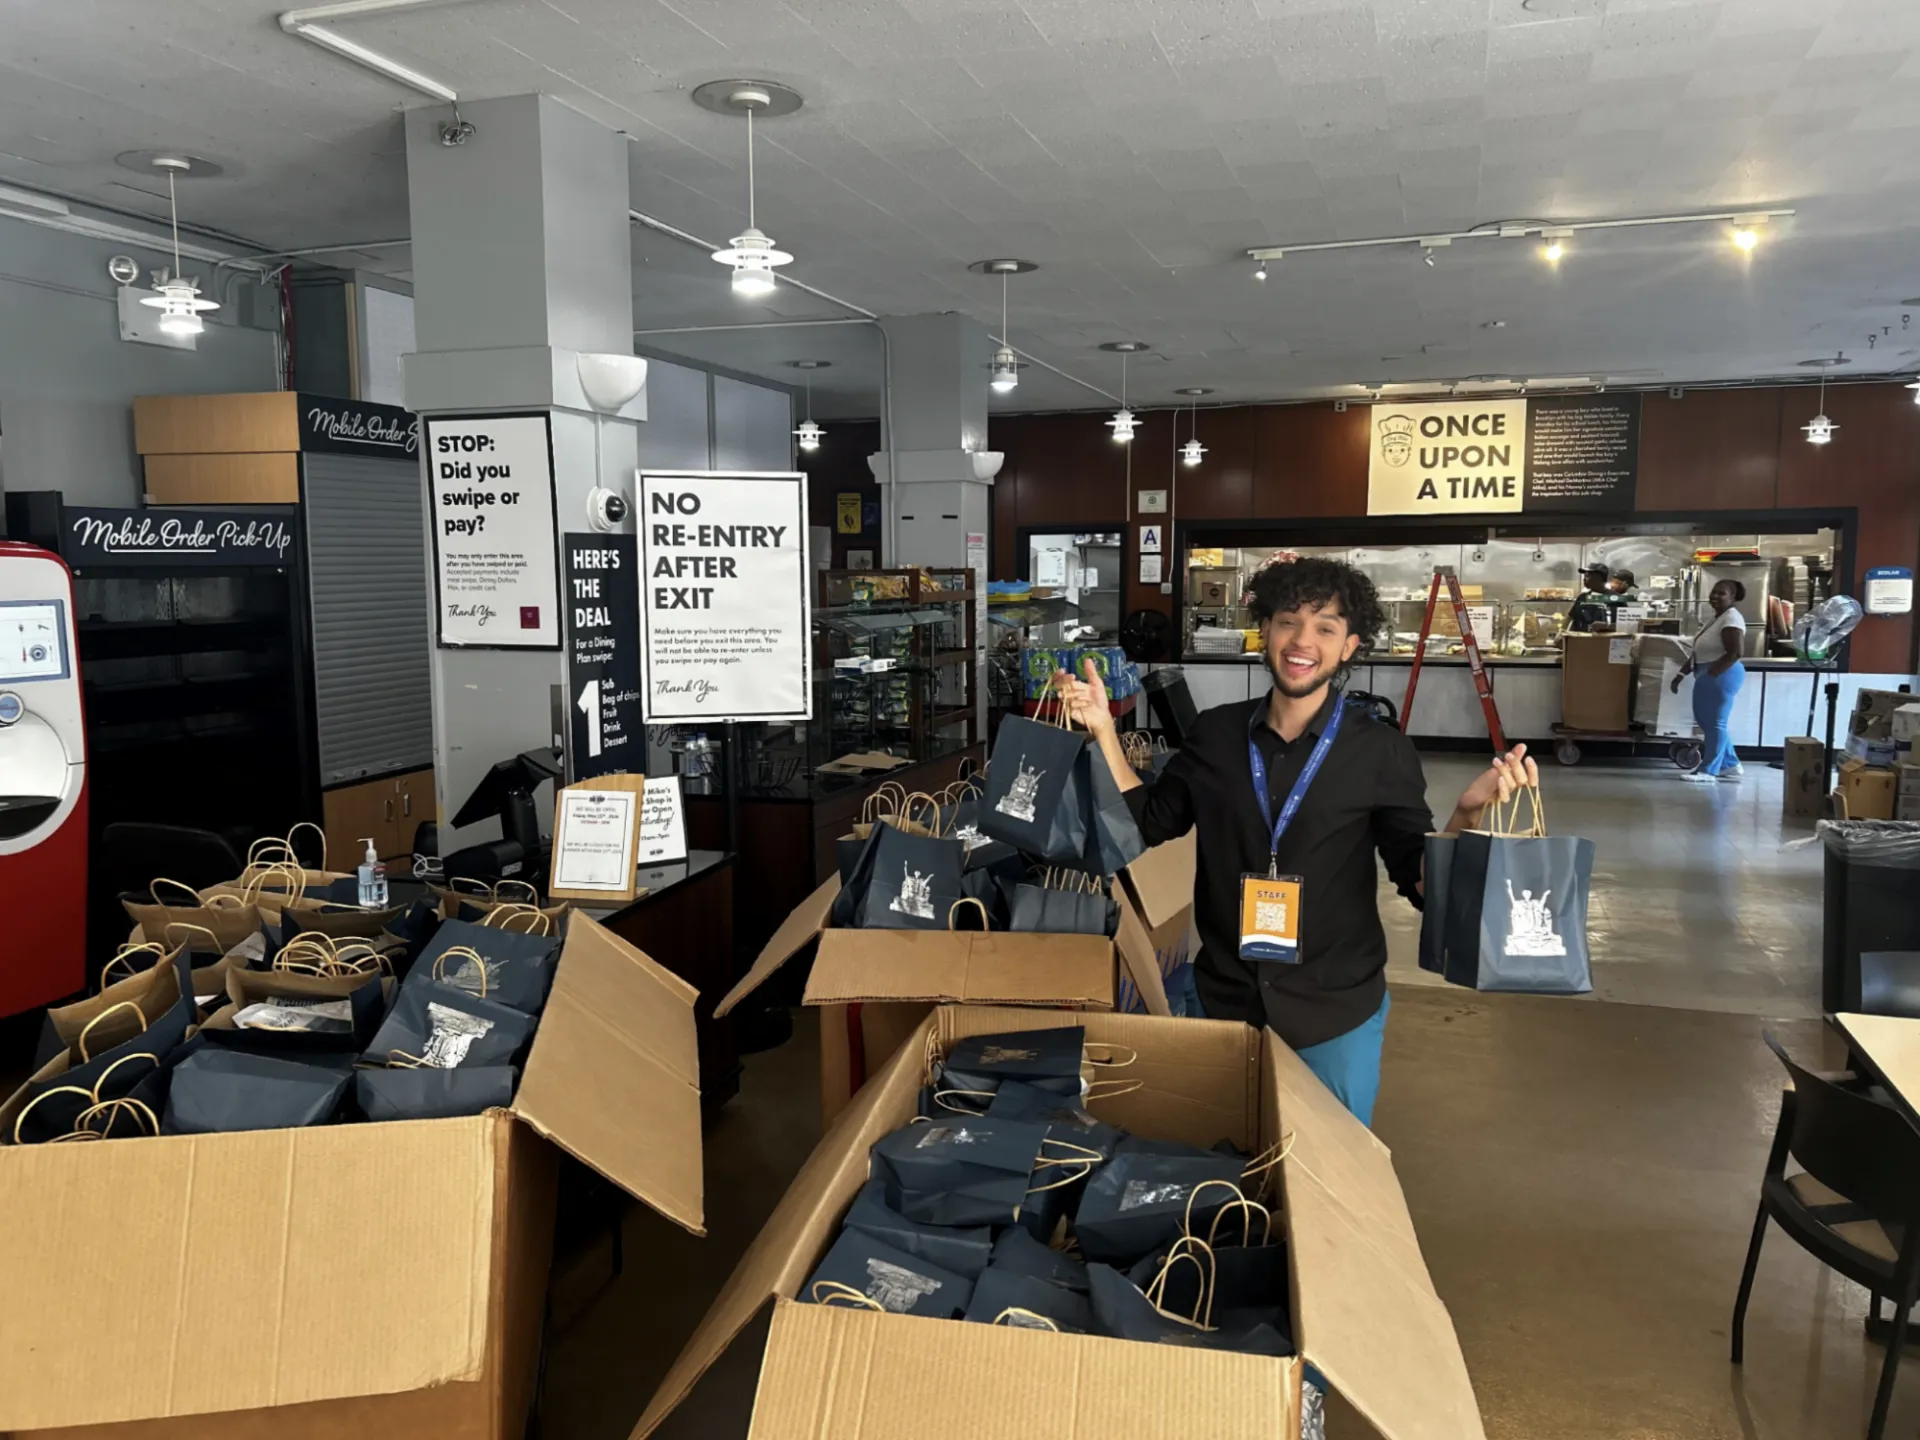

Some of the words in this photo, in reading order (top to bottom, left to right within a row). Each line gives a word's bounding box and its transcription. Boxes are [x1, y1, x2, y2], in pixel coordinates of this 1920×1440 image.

[308, 408, 366, 438] Mobile
[368, 416, 405, 441] Order
[1420, 414, 1506, 438] ONCE
[438, 435, 495, 453] STOP:
[1420, 446, 1510, 469] UPON
[440, 461, 472, 479] Did
[477, 464, 510, 482] you
[443, 488, 496, 509] swipe
[501, 492, 519, 505] or
[1417, 479, 1438, 499] A
[1447, 477, 1515, 498] TIME
[652, 492, 701, 515] NO
[445, 515, 485, 535] pay?
[74, 516, 158, 552] Mobile
[160, 520, 216, 548] Order
[217, 520, 290, 558] Pick-Up
[653, 524, 787, 548] RE-ENTRY
[1144, 529, 1157, 545] A
[573, 549, 620, 569] HERE'S
[653, 556, 738, 578] AFTER
[573, 579, 600, 598] THE
[654, 587, 714, 609] EXIT
[448, 604, 476, 617] Thank
[477, 605, 496, 626] You
[576, 608, 611, 628] DEAL
[576, 639, 586, 649] For
[595, 637, 615, 649] Dining
[576, 654, 591, 664] Plan
[592, 652, 613, 664] swipe:
[602, 678, 615, 690] Sub
[656, 680, 692, 694] Thank
[694, 679, 719, 703] You
[602, 694, 615, 706] Bag
[617, 691, 624, 702] of
[624, 689, 639, 701] chips
[578, 680, 601, 757] 1
[603, 708, 617, 719] Fruit
[604, 722, 620, 733] Drink
[604, 735, 627, 748] Dessert
